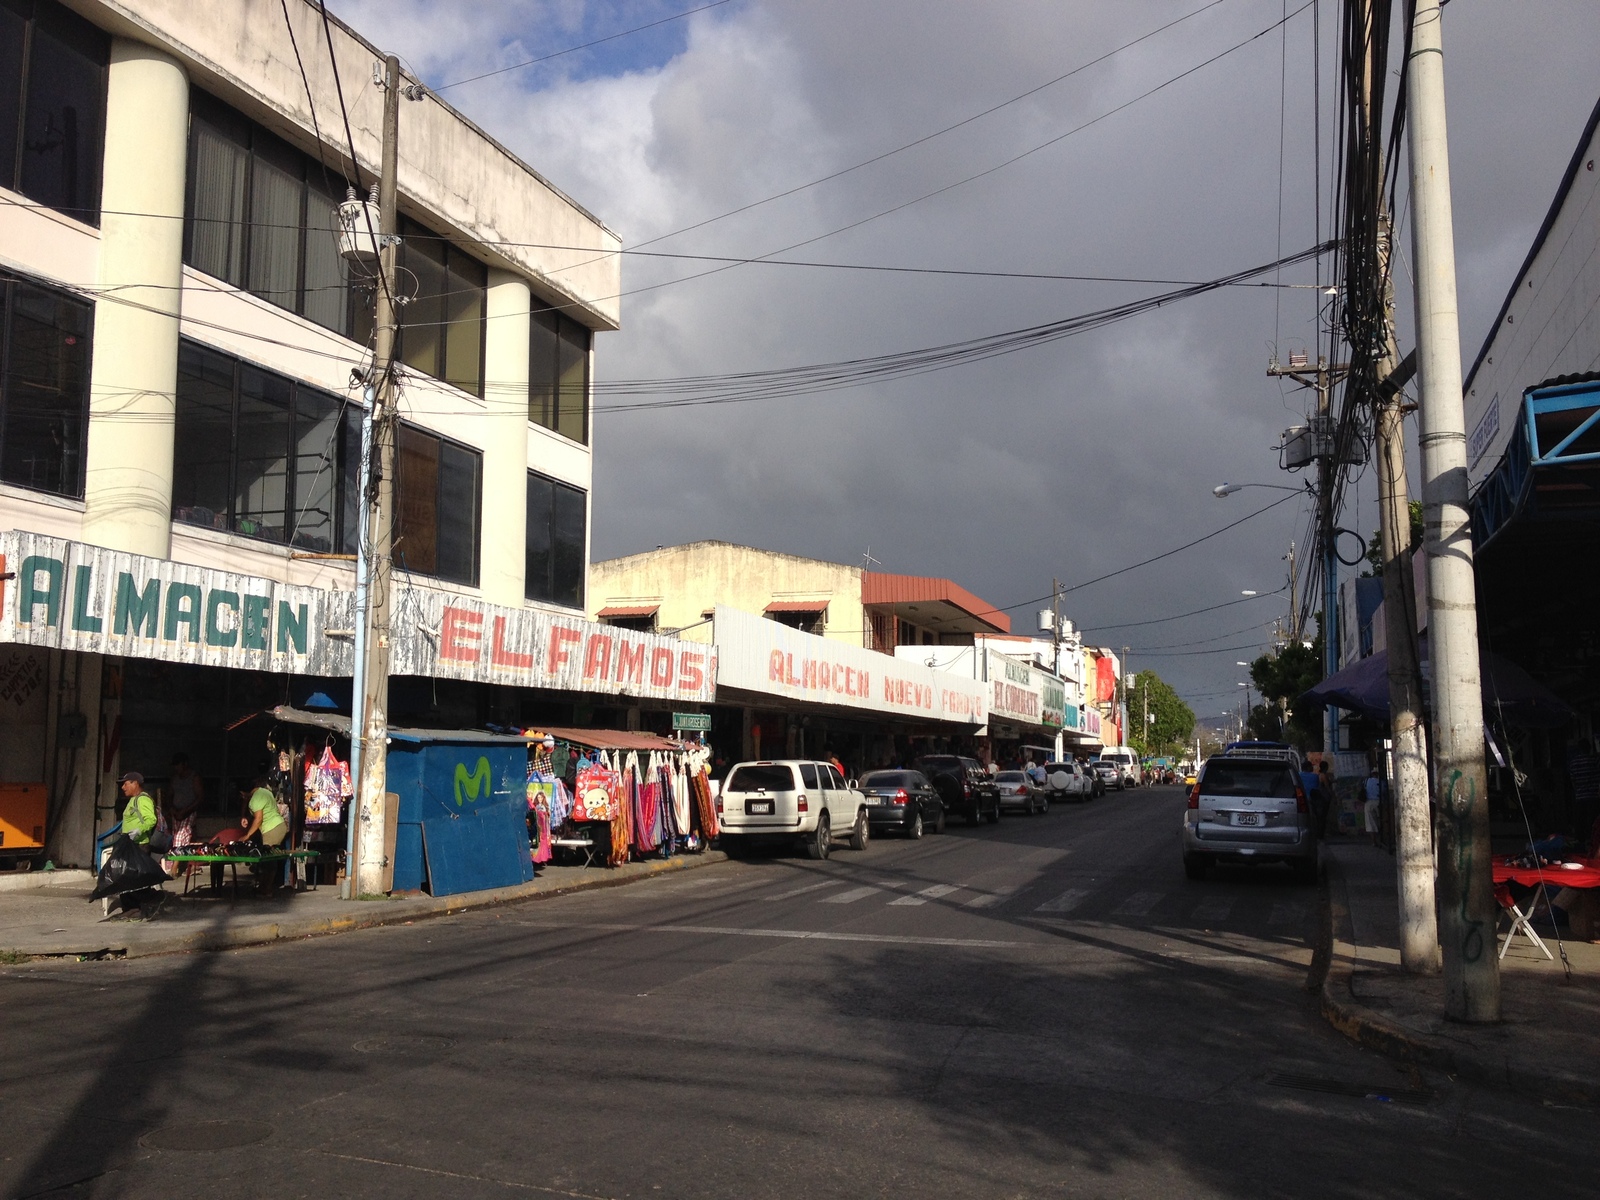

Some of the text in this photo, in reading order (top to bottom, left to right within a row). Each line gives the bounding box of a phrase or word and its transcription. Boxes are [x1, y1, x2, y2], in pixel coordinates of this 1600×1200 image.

[20, 555, 308, 655] ALMACEN
[440, 606, 534, 669] EL
[768, 649, 870, 699] ALMACEN
[884, 675, 932, 710] NUEVO
